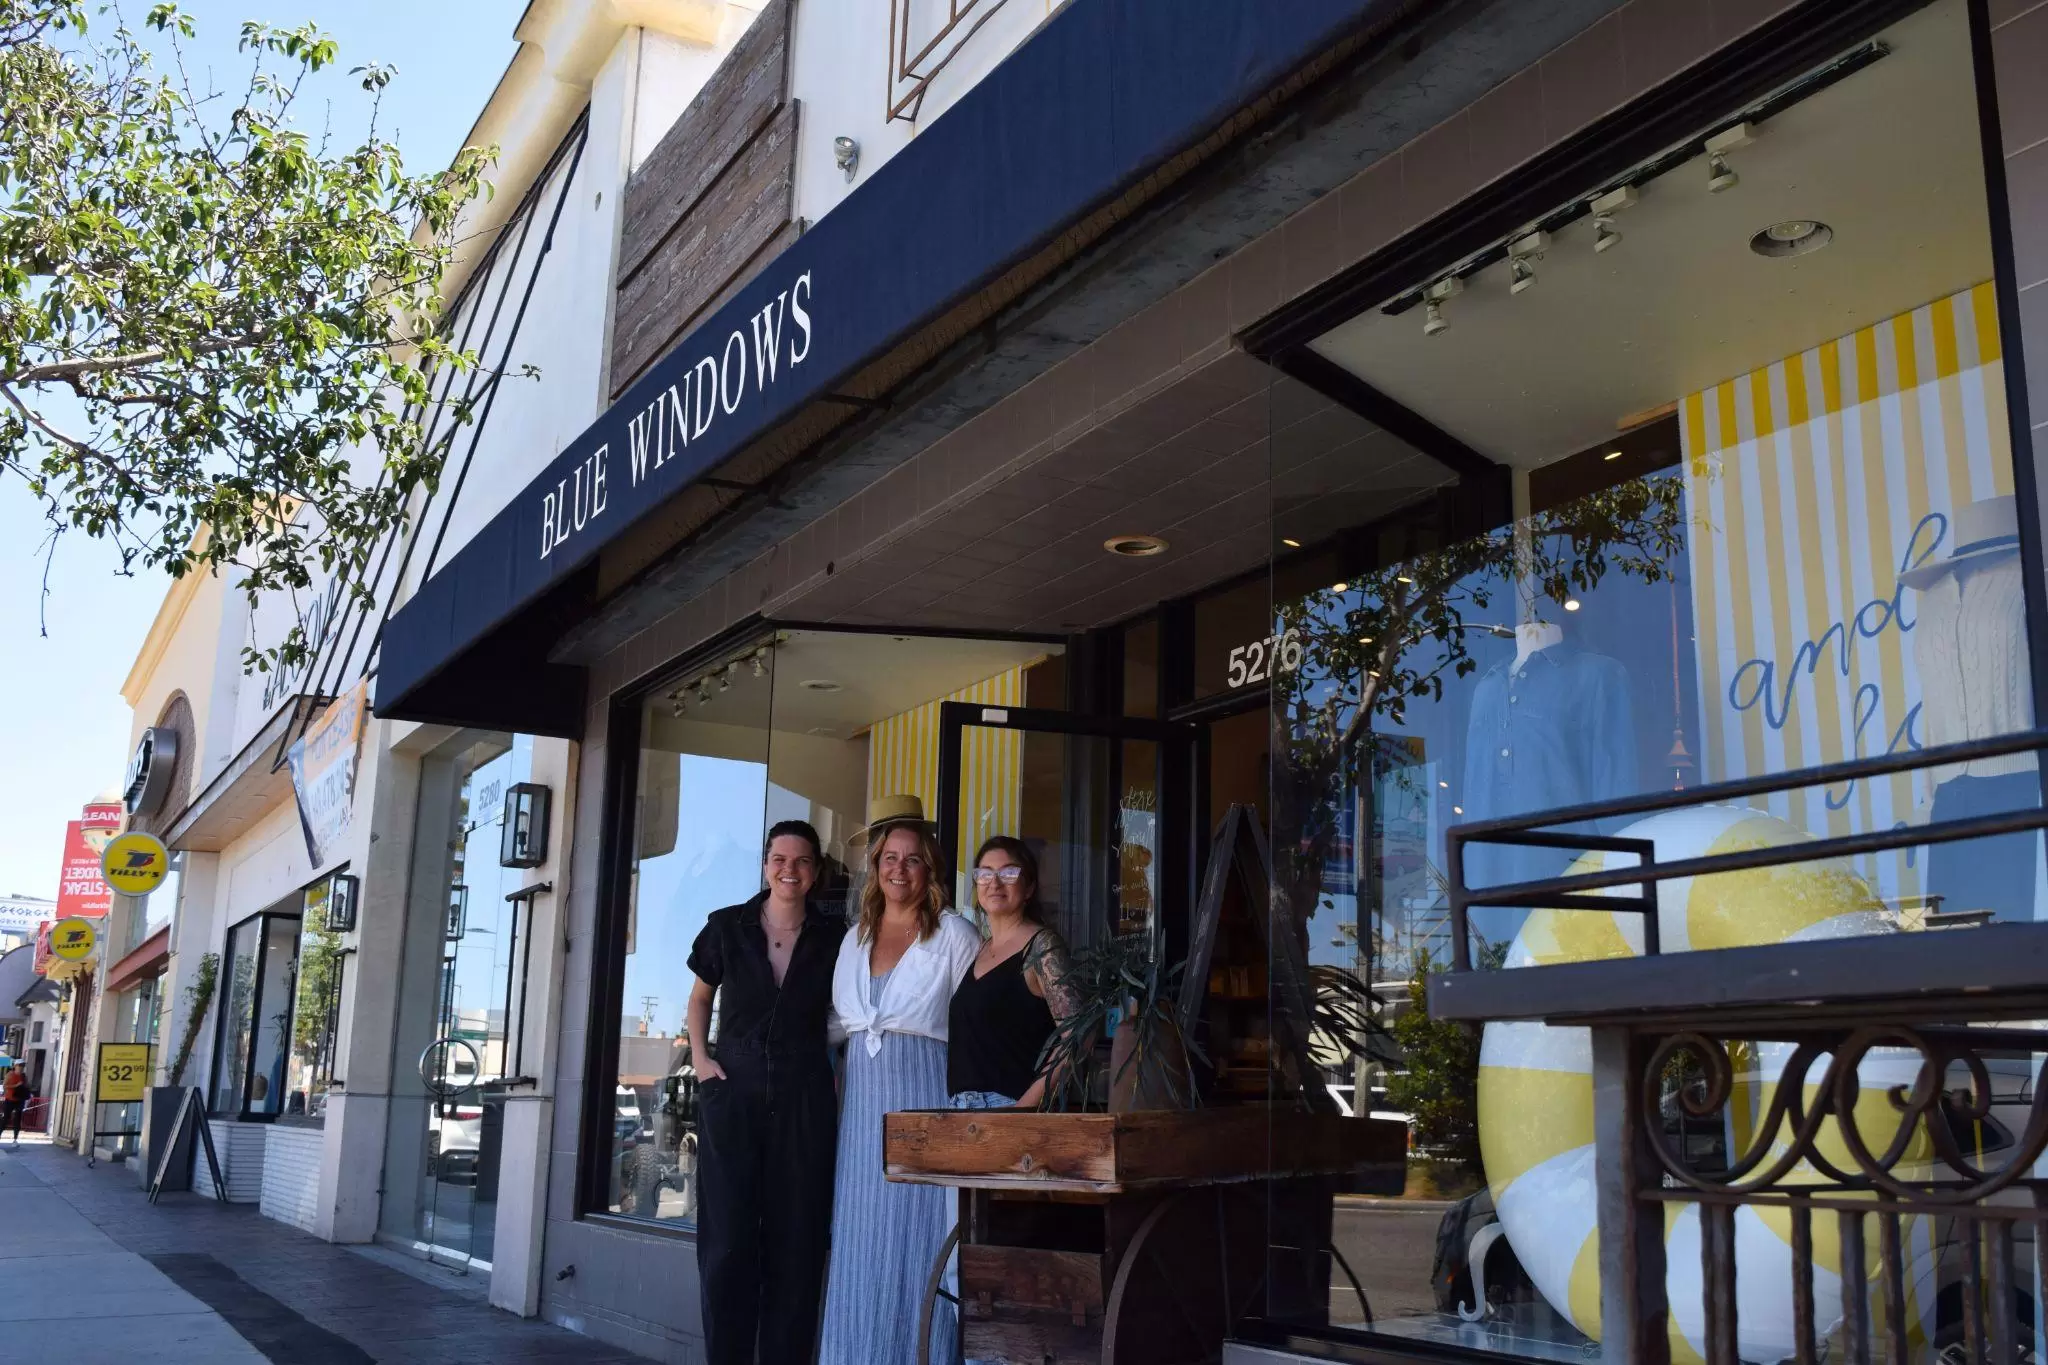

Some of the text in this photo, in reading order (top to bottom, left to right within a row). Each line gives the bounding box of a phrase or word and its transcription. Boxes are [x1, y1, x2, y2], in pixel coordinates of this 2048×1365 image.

[540, 269, 812, 560] BLUE WINDOWS
[1729, 512, 1948, 730] and
[1227, 628, 1301, 688] 5276
[479, 779, 501, 811] 5280
[109, 867, 160, 878] TILLY'S
[0, 906, 54, 917] GEORGE'
